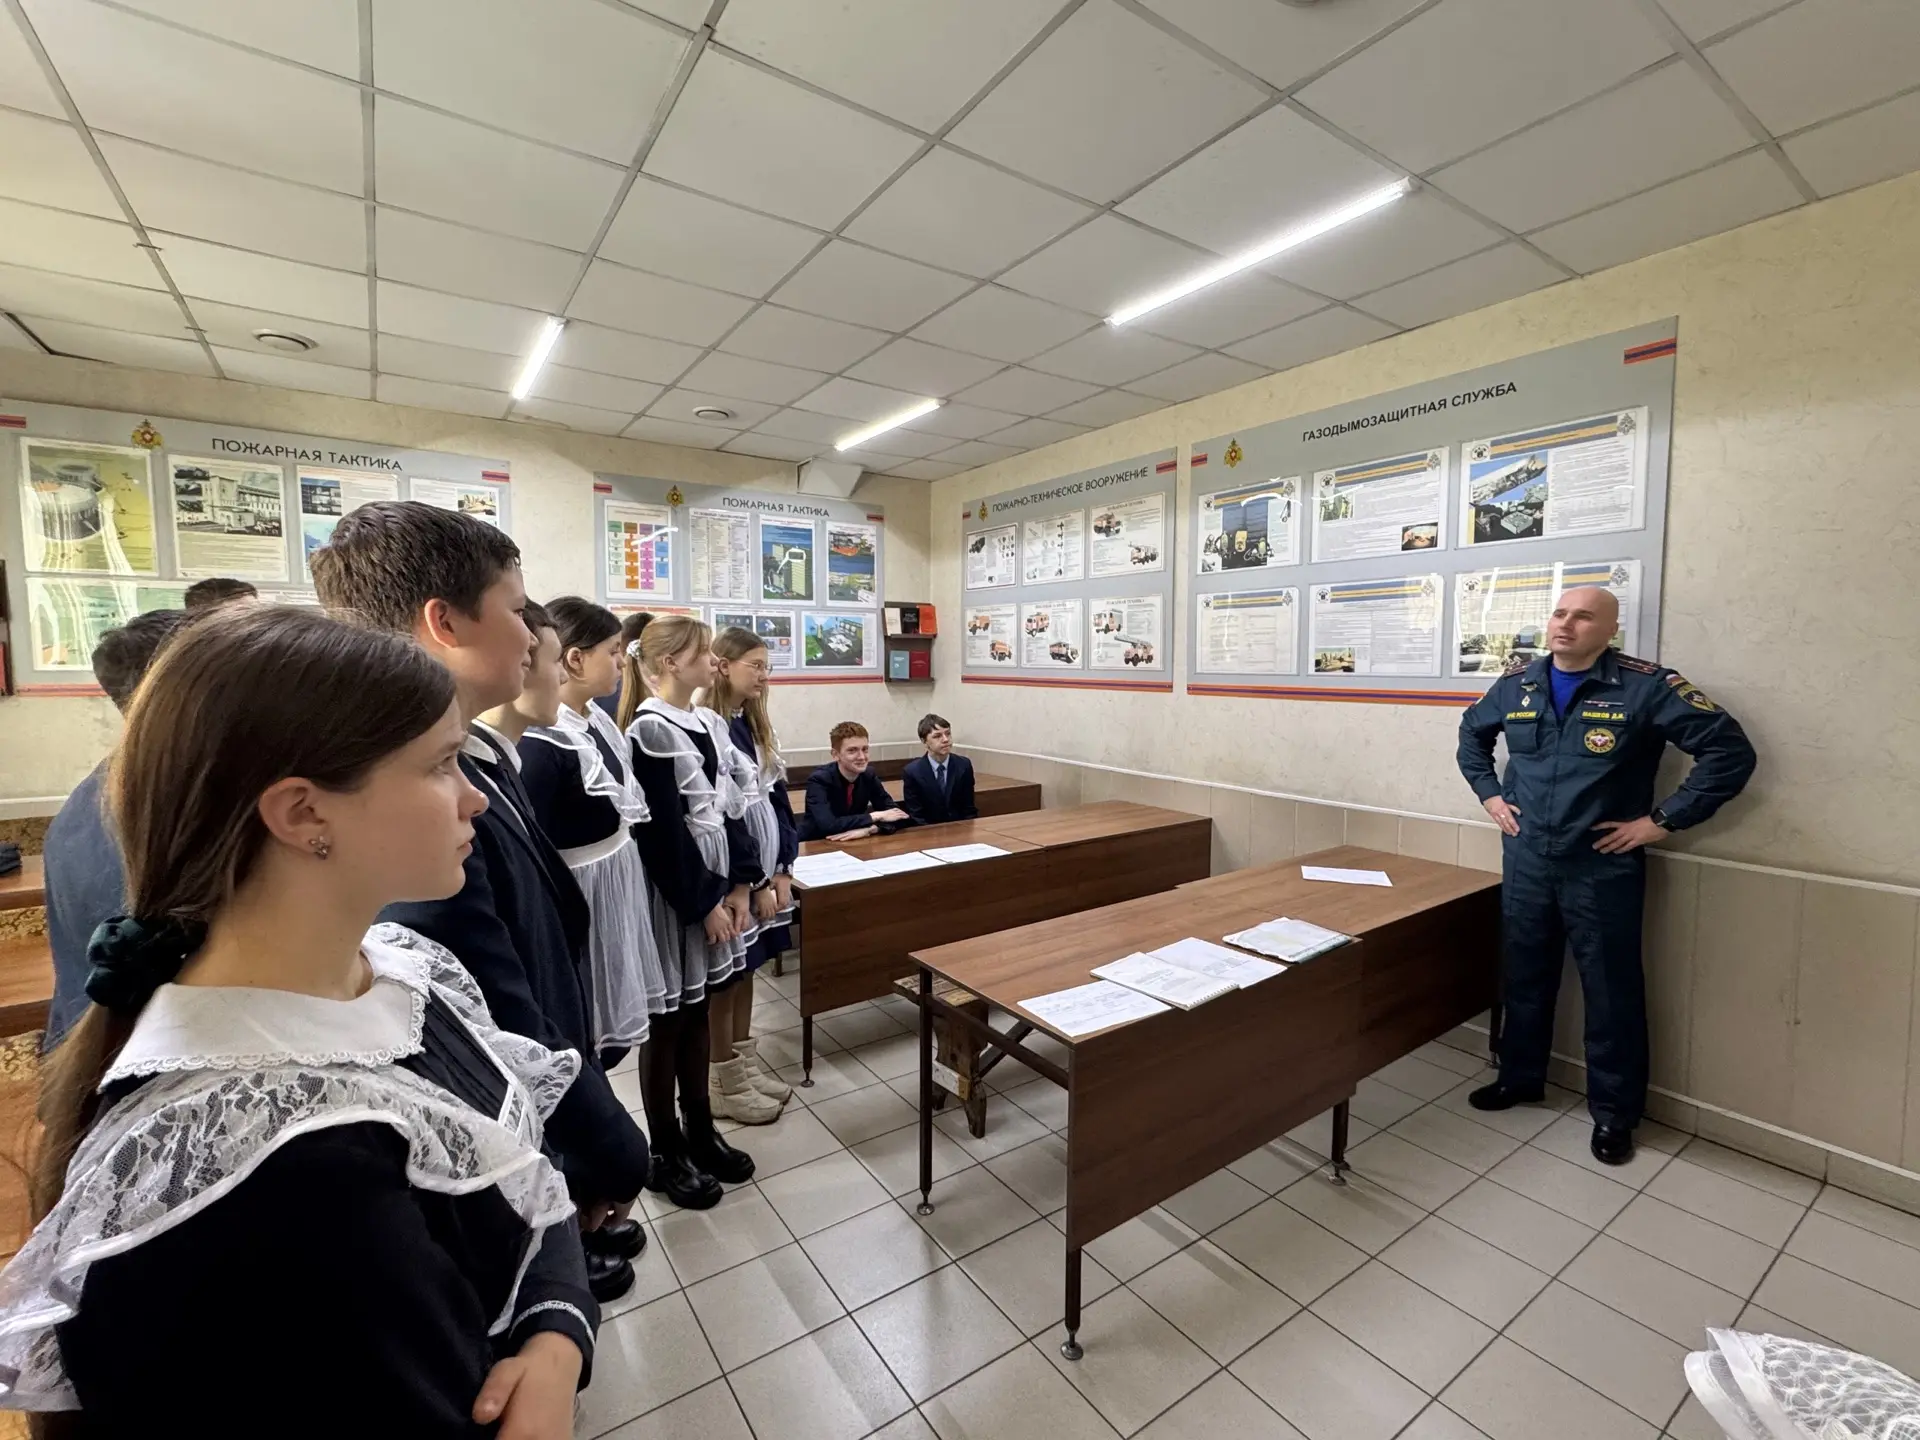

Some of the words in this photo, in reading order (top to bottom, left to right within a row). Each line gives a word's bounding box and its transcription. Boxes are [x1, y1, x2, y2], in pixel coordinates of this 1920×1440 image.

[1302, 398, 1448, 442] ГАЗОДЫМОЗАЩИТНАЯ
[1451, 382, 1517, 408] СЛУЖБА
[212, 438, 322, 462] ПОЖАРНАЯ
[328, 451, 403, 471] ТАКТИКА
[722, 497, 784, 512] ПОЖАРНАЯ
[787, 504, 830, 517] ТАКТИКА
[992, 483, 1083, 513] ПОЖАРНО-ТЕХНИЧЕСКОЕ
[1085, 466, 1149, 491] ВООРУЖЕНИЕ
